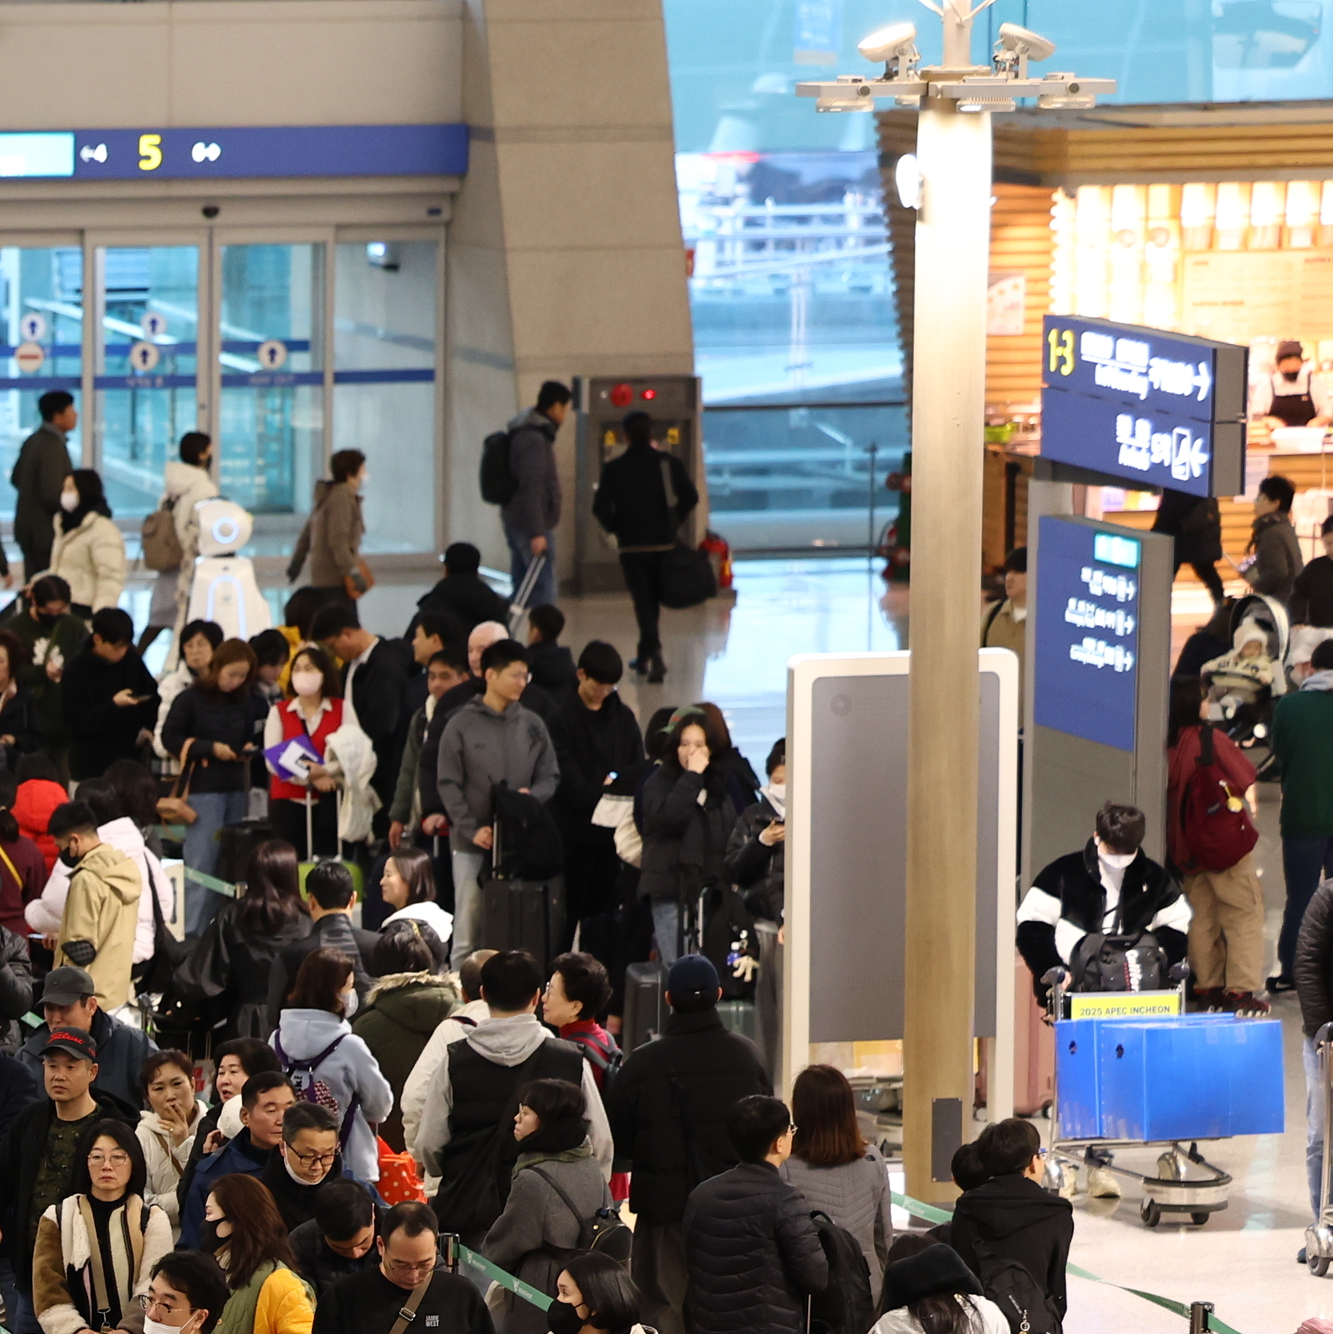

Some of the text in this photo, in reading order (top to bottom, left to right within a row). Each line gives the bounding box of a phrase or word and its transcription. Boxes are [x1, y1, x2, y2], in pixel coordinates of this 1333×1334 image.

[138, 134, 162, 170] 5
[1080, 1005, 1171, 1017] 2025 APEC INCHEON
[425, 1320, 439, 1328] WEST
